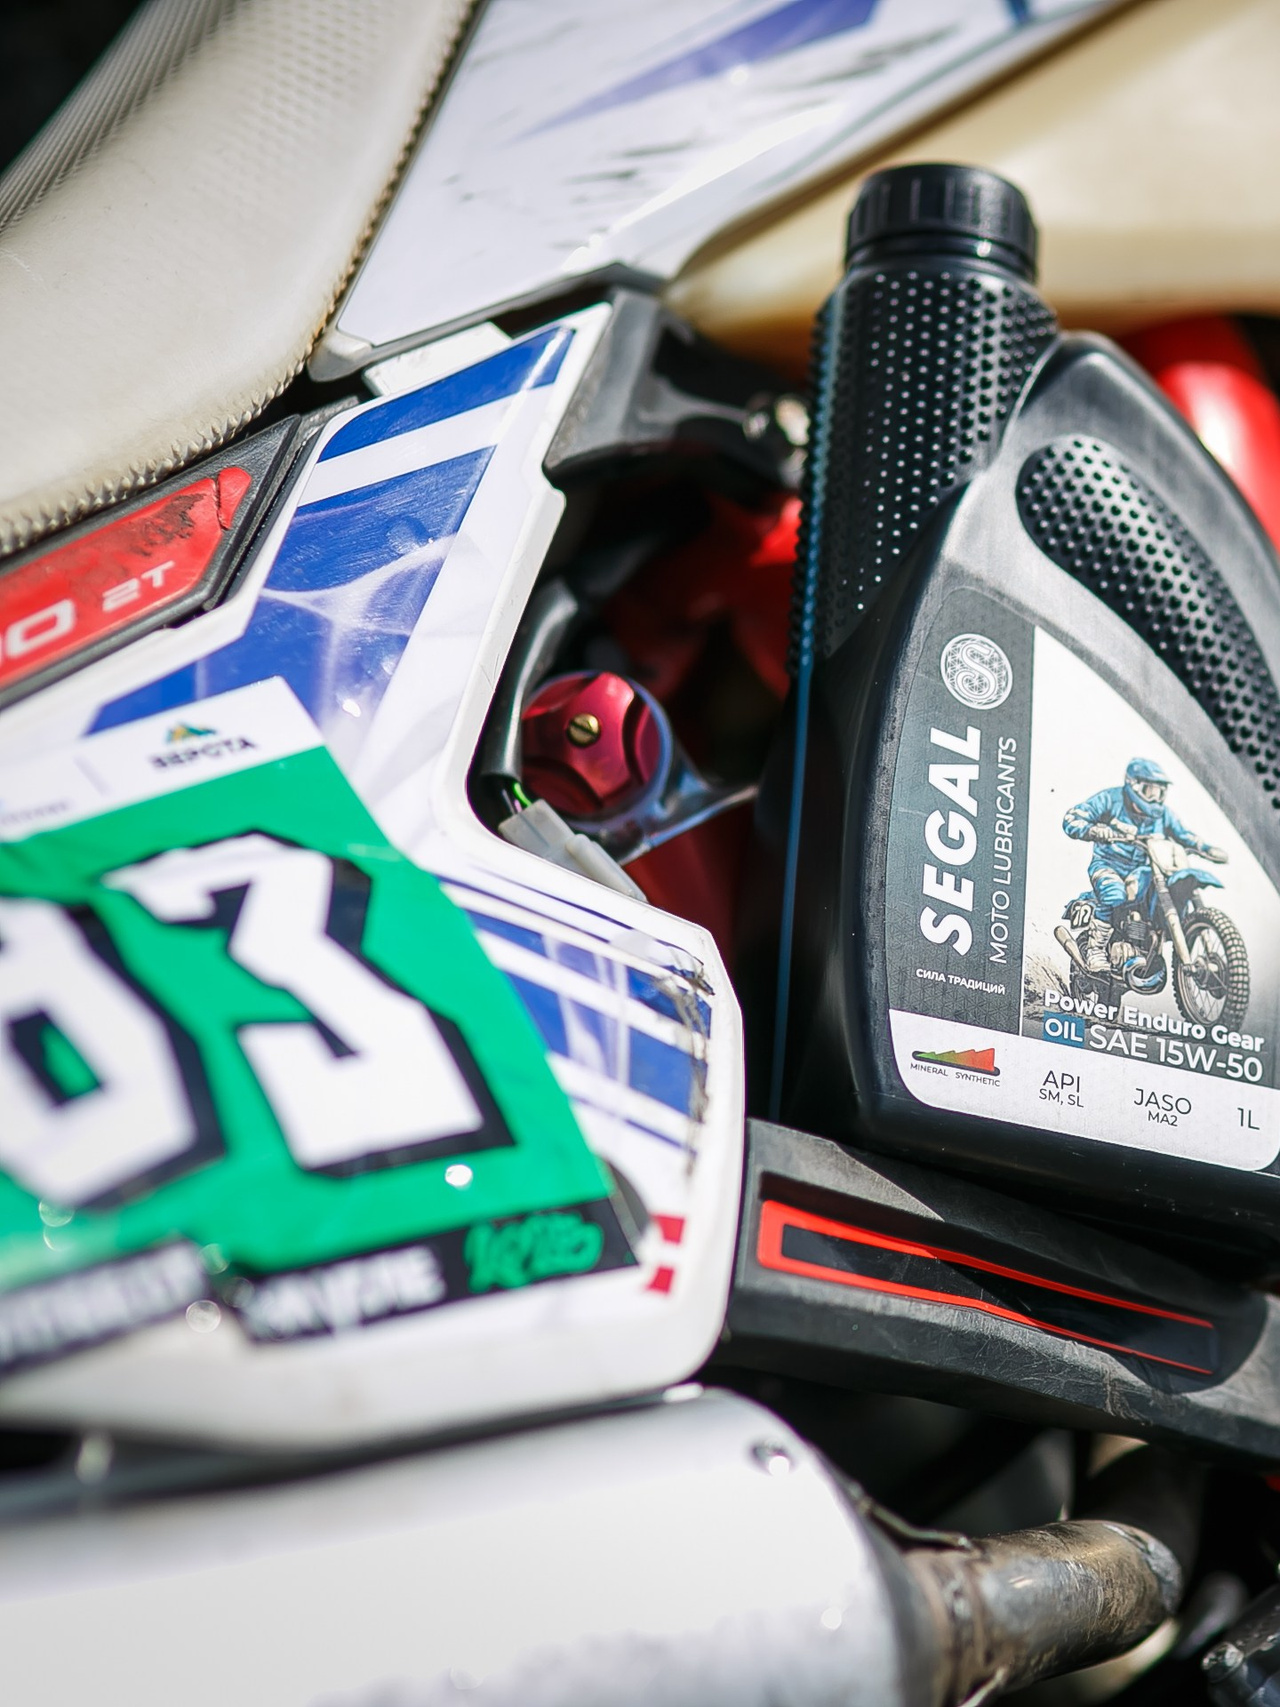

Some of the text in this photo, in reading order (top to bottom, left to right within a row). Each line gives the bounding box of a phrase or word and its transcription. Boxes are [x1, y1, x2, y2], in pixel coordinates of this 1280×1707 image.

[0, 559, 176, 668] 0 2T
[919, 725, 982, 956] SEGAL
[989, 736, 1017, 964] MOTO LUBRICANTS
[915, 968, 1006, 996] СИЛА ТРАДИЦИЙ
[1044, 988, 1265, 1053] Power Enduro Gear
[1044, 1018, 1264, 1083] OIL SAE 15W-50
[910, 1062, 1001, 1088] MINERAL SYNTHETIC
[1042, 1070, 1081, 1093] API
[1039, 1088, 1085, 1108] SM, SL
[1133, 1088, 1192, 1115] JASO
[1147, 1110, 1178, 1127] MA2
[1237, 1107, 1260, 1131] 1L
